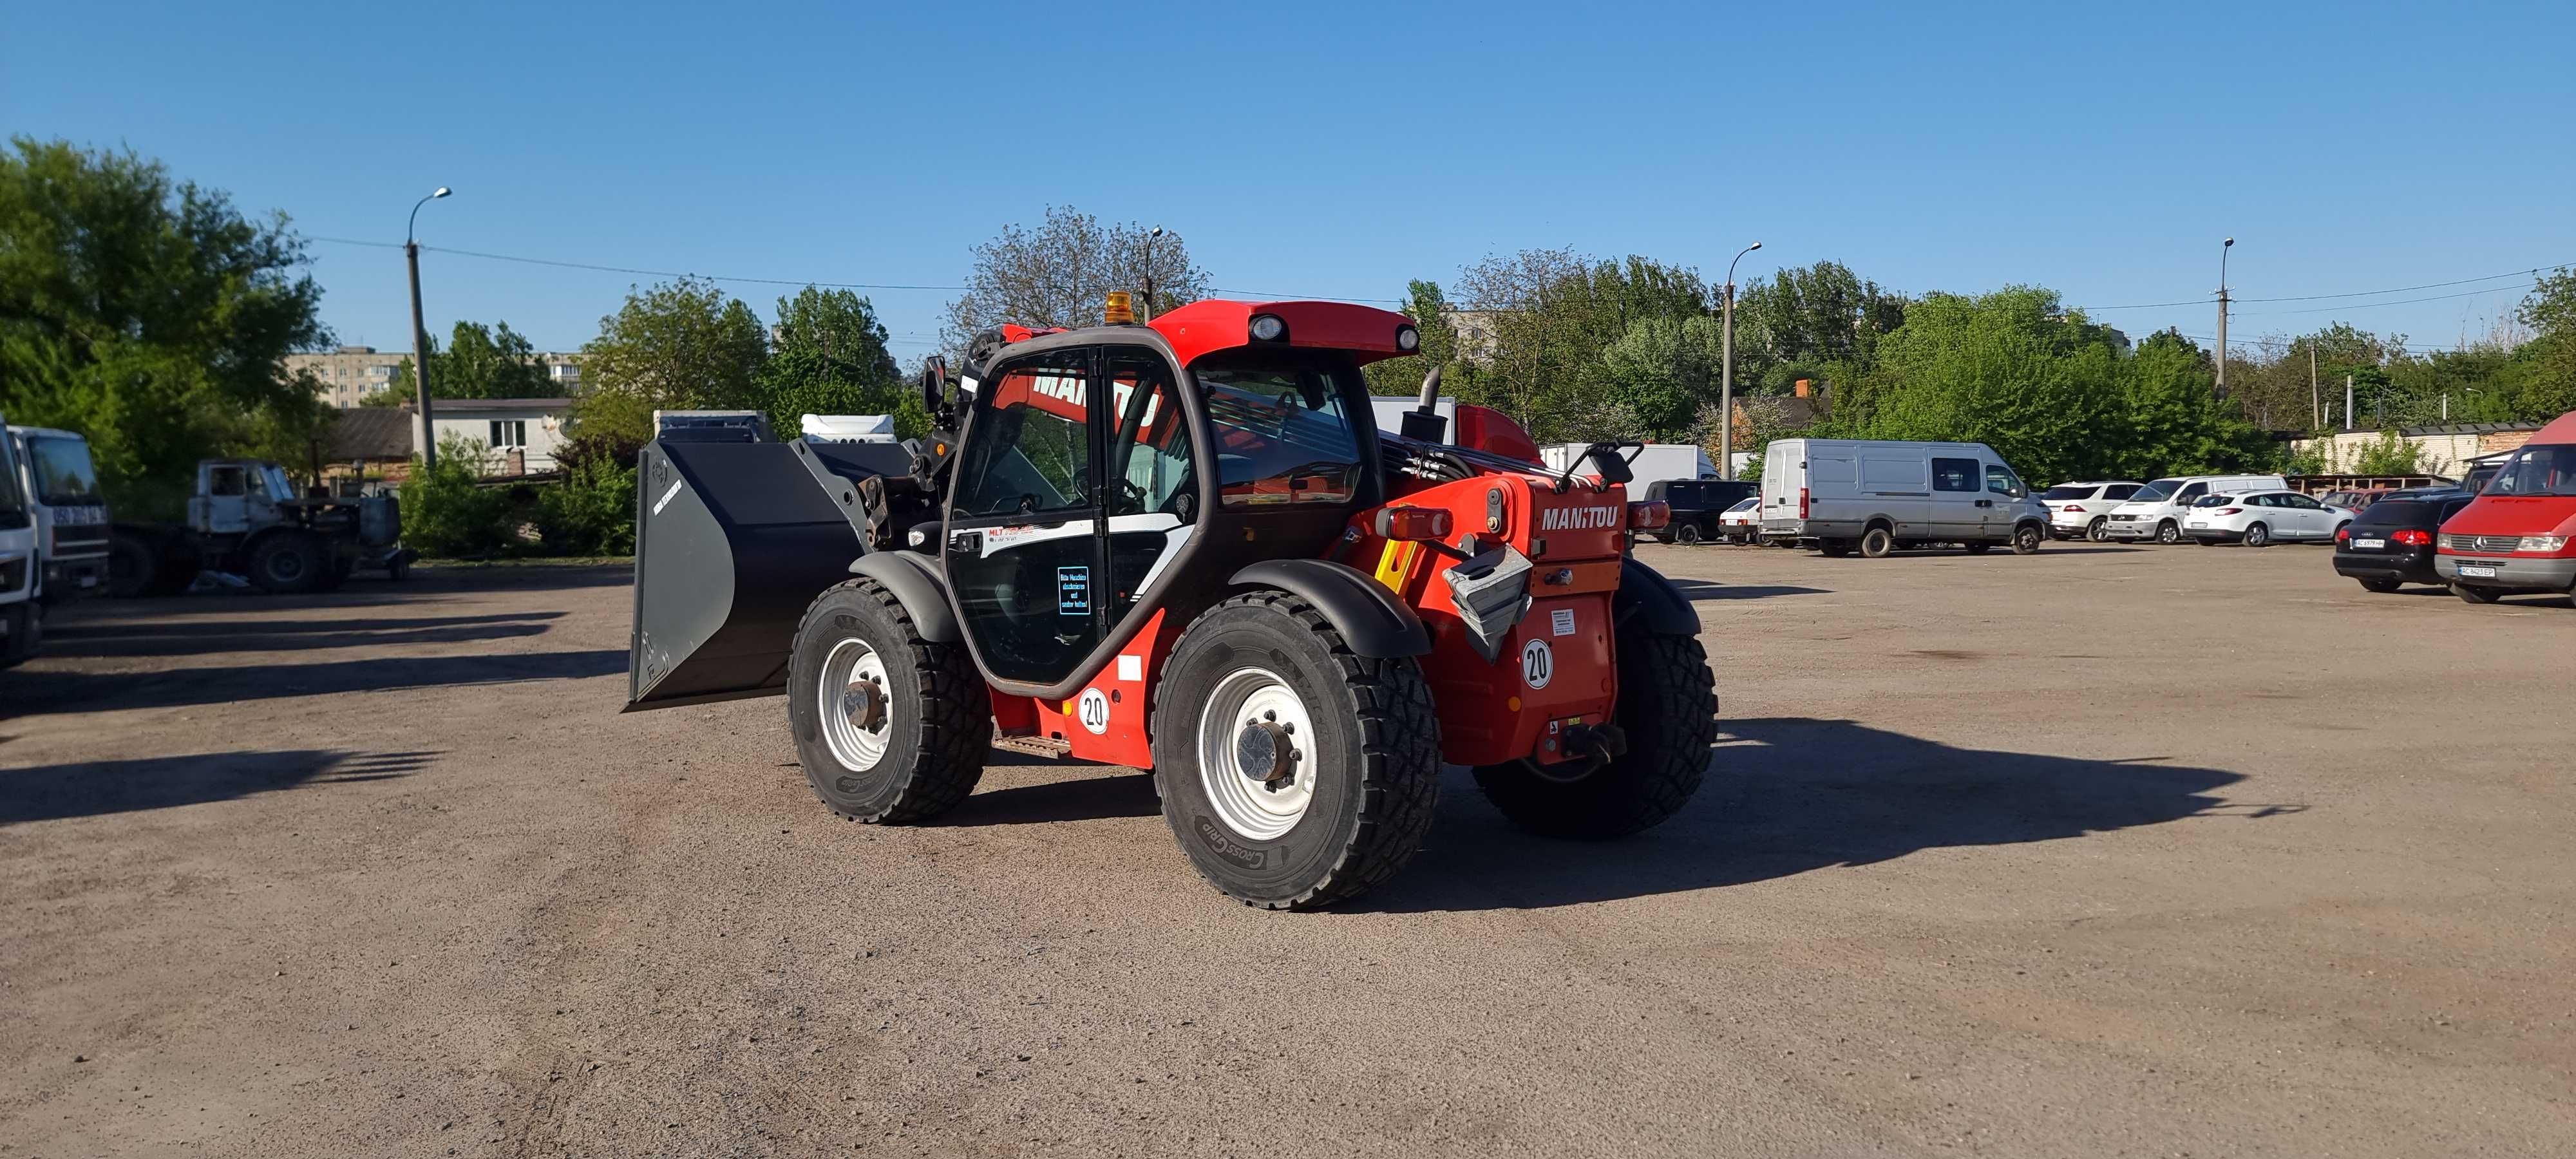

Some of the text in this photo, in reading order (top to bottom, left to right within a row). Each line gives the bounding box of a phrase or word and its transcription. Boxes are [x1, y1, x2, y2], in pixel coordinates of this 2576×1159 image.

[1542, 506, 1618, 530] MANITOU
[1527, 648, 1547, 681] 20
[1084, 697, 1103, 726] 20
